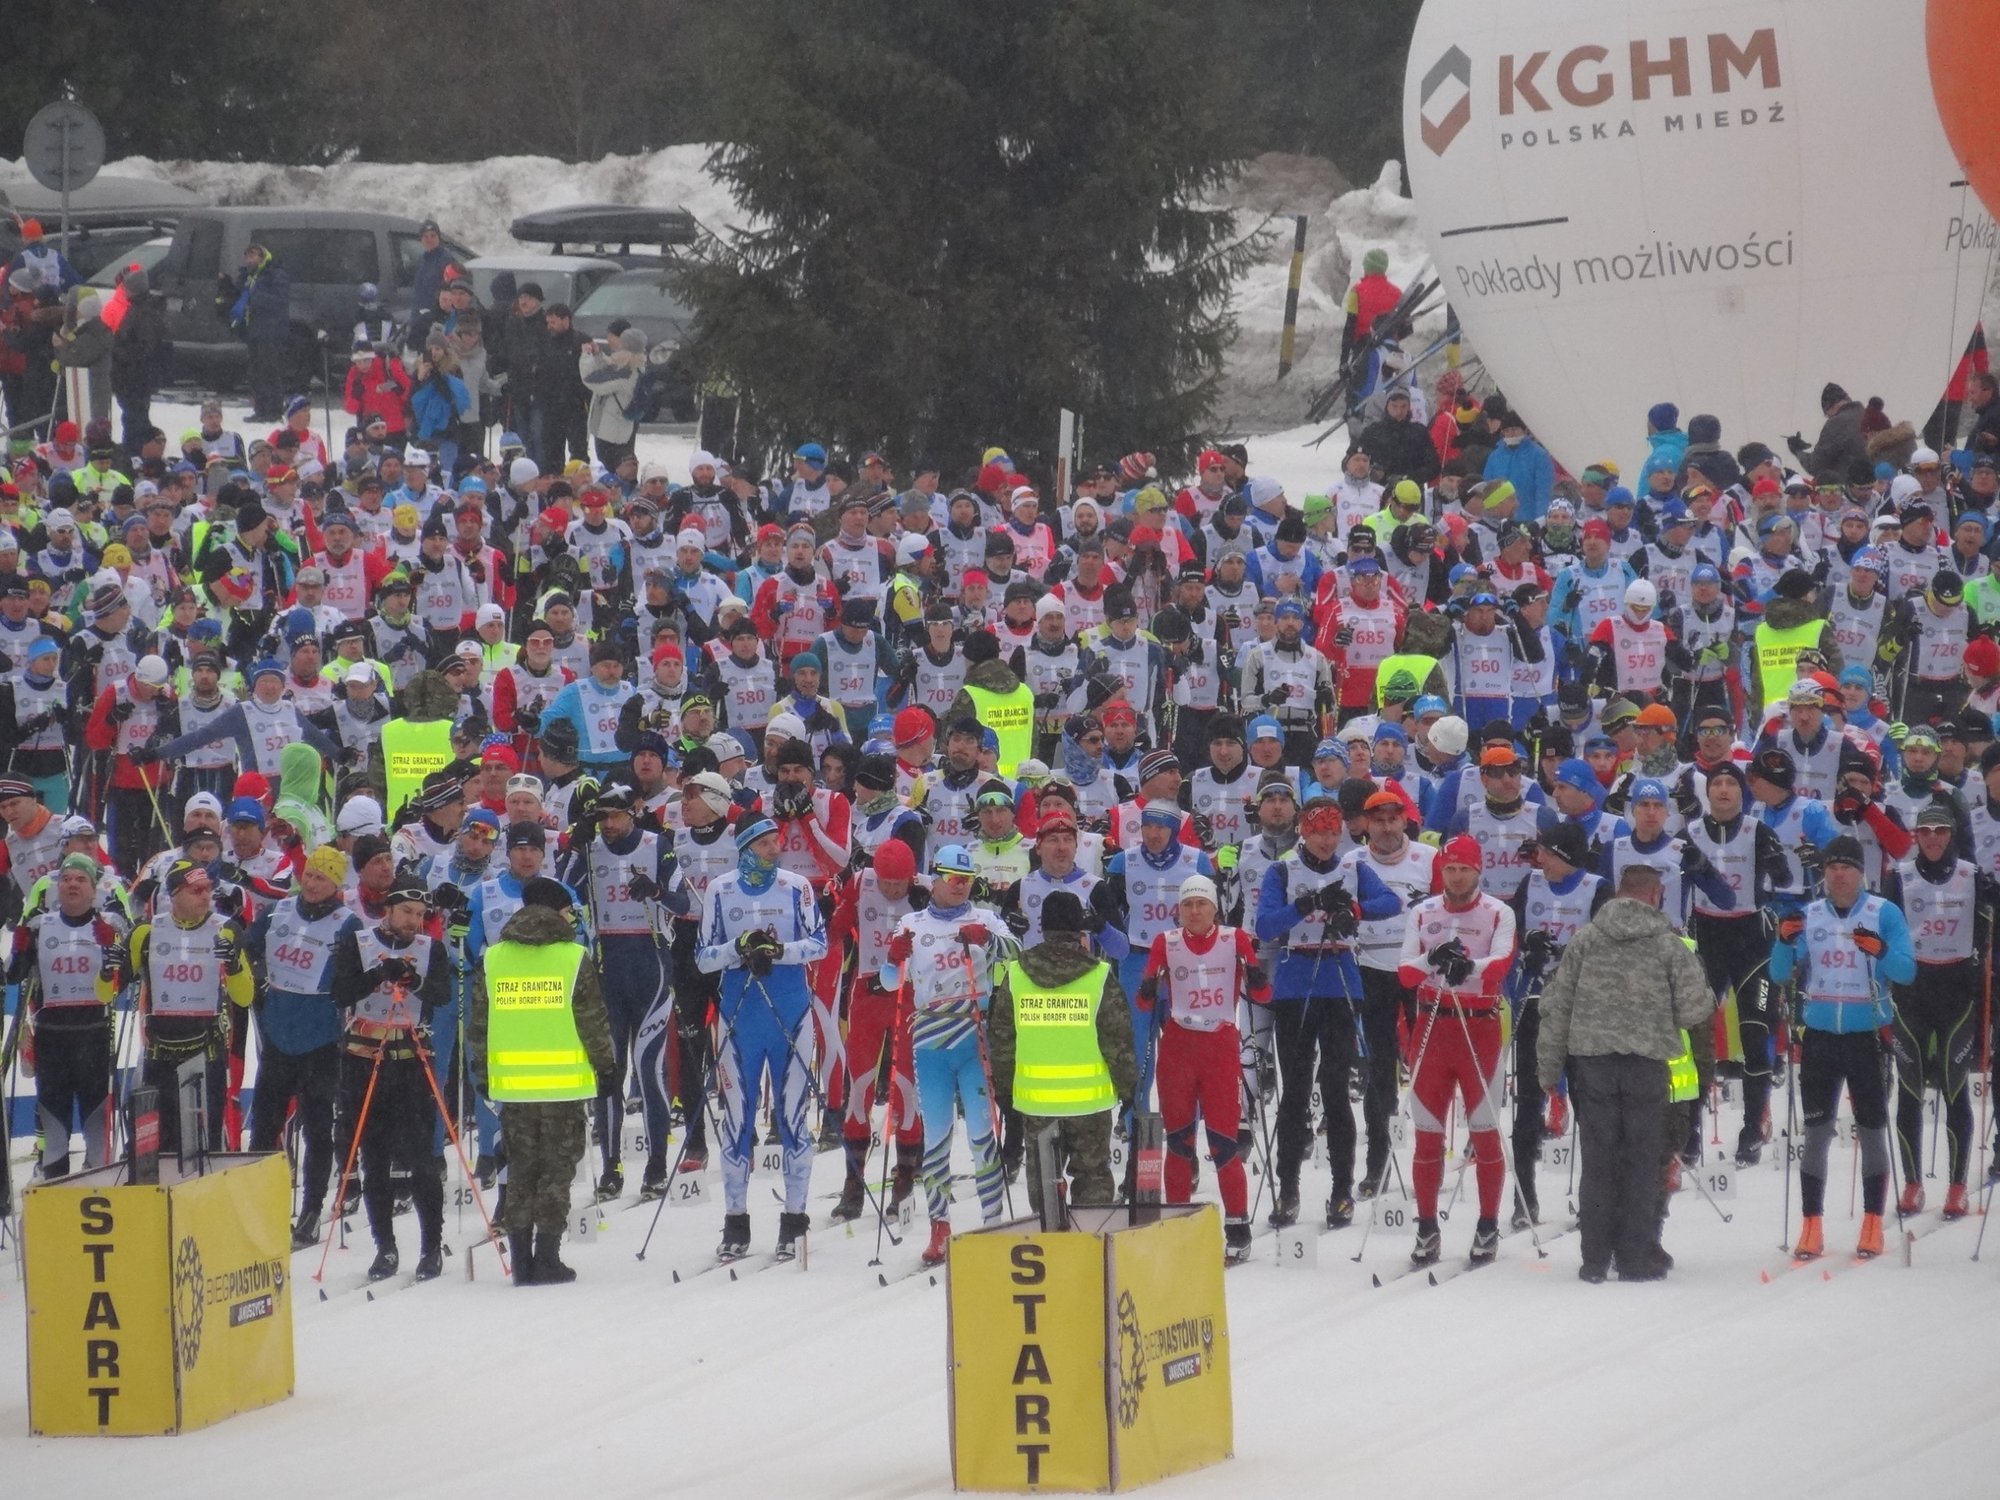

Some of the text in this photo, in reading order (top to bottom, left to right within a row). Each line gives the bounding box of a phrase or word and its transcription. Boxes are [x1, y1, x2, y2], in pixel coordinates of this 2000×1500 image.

[1498, 28, 1783, 116] KGHM
[1500, 101, 1786, 150] POLSKA MIEDŹ
[1945, 213, 1998, 251] Pokła
[1456, 231, 1794, 298] Pokłady możliwości
[850, 571, 867, 584] 81
[326, 587, 355, 601] 652
[426, 594, 454, 609] 569
[1588, 597, 1618, 613] 556
[1355, 630, 1385, 645] 685
[1836, 629, 1867, 647] 657
[1930, 642, 1960, 658] 726
[104, 660, 130, 677] 616
[1470, 659, 1500, 674] 560
[1627, 653, 1657, 669] 579
[839, 676, 865, 691] 547
[1188, 675, 1207, 690] 10
[1511, 668, 1542, 684] 520
[735, 689, 766, 706] 580
[926, 688, 955, 703] 703
[129, 725, 150, 738] 68
[598, 717, 618, 732] 66
[412, 756, 444, 766] GRANICZNA
[936, 819, 968, 837] 48
[1485, 850, 1523, 869] 344
[1143, 903, 1181, 922] 304
[1919, 918, 1960, 938] 397
[50, 956, 91, 974] 418
[273, 943, 315, 970] 448
[1819, 950, 1858, 969] 491
[162, 963, 204, 983] 480
[521, 981, 563, 993] GRANICZNA
[496, 994, 563, 1005] POLISH BORDER GUARD
[1046, 997, 1089, 1009] GRANICZNA
[1187, 988, 1224, 1010] 256
[1020, 1012, 1089, 1022] POLISH BORDER GUARD
[762, 1153, 781, 1171] 40
[1552, 1147, 1570, 1165] 37
[679, 1179, 701, 1201] 24
[1708, 1174, 1729, 1192] 19
[454, 1186, 474, 1207] 25
[579, 1217, 588, 1235] 5
[1383, 1209, 1405, 1227] 60
[1293, 1240, 1304, 1260] 3
[79, 1196, 121, 1427] START
[1010, 1243, 1053, 1485] START
